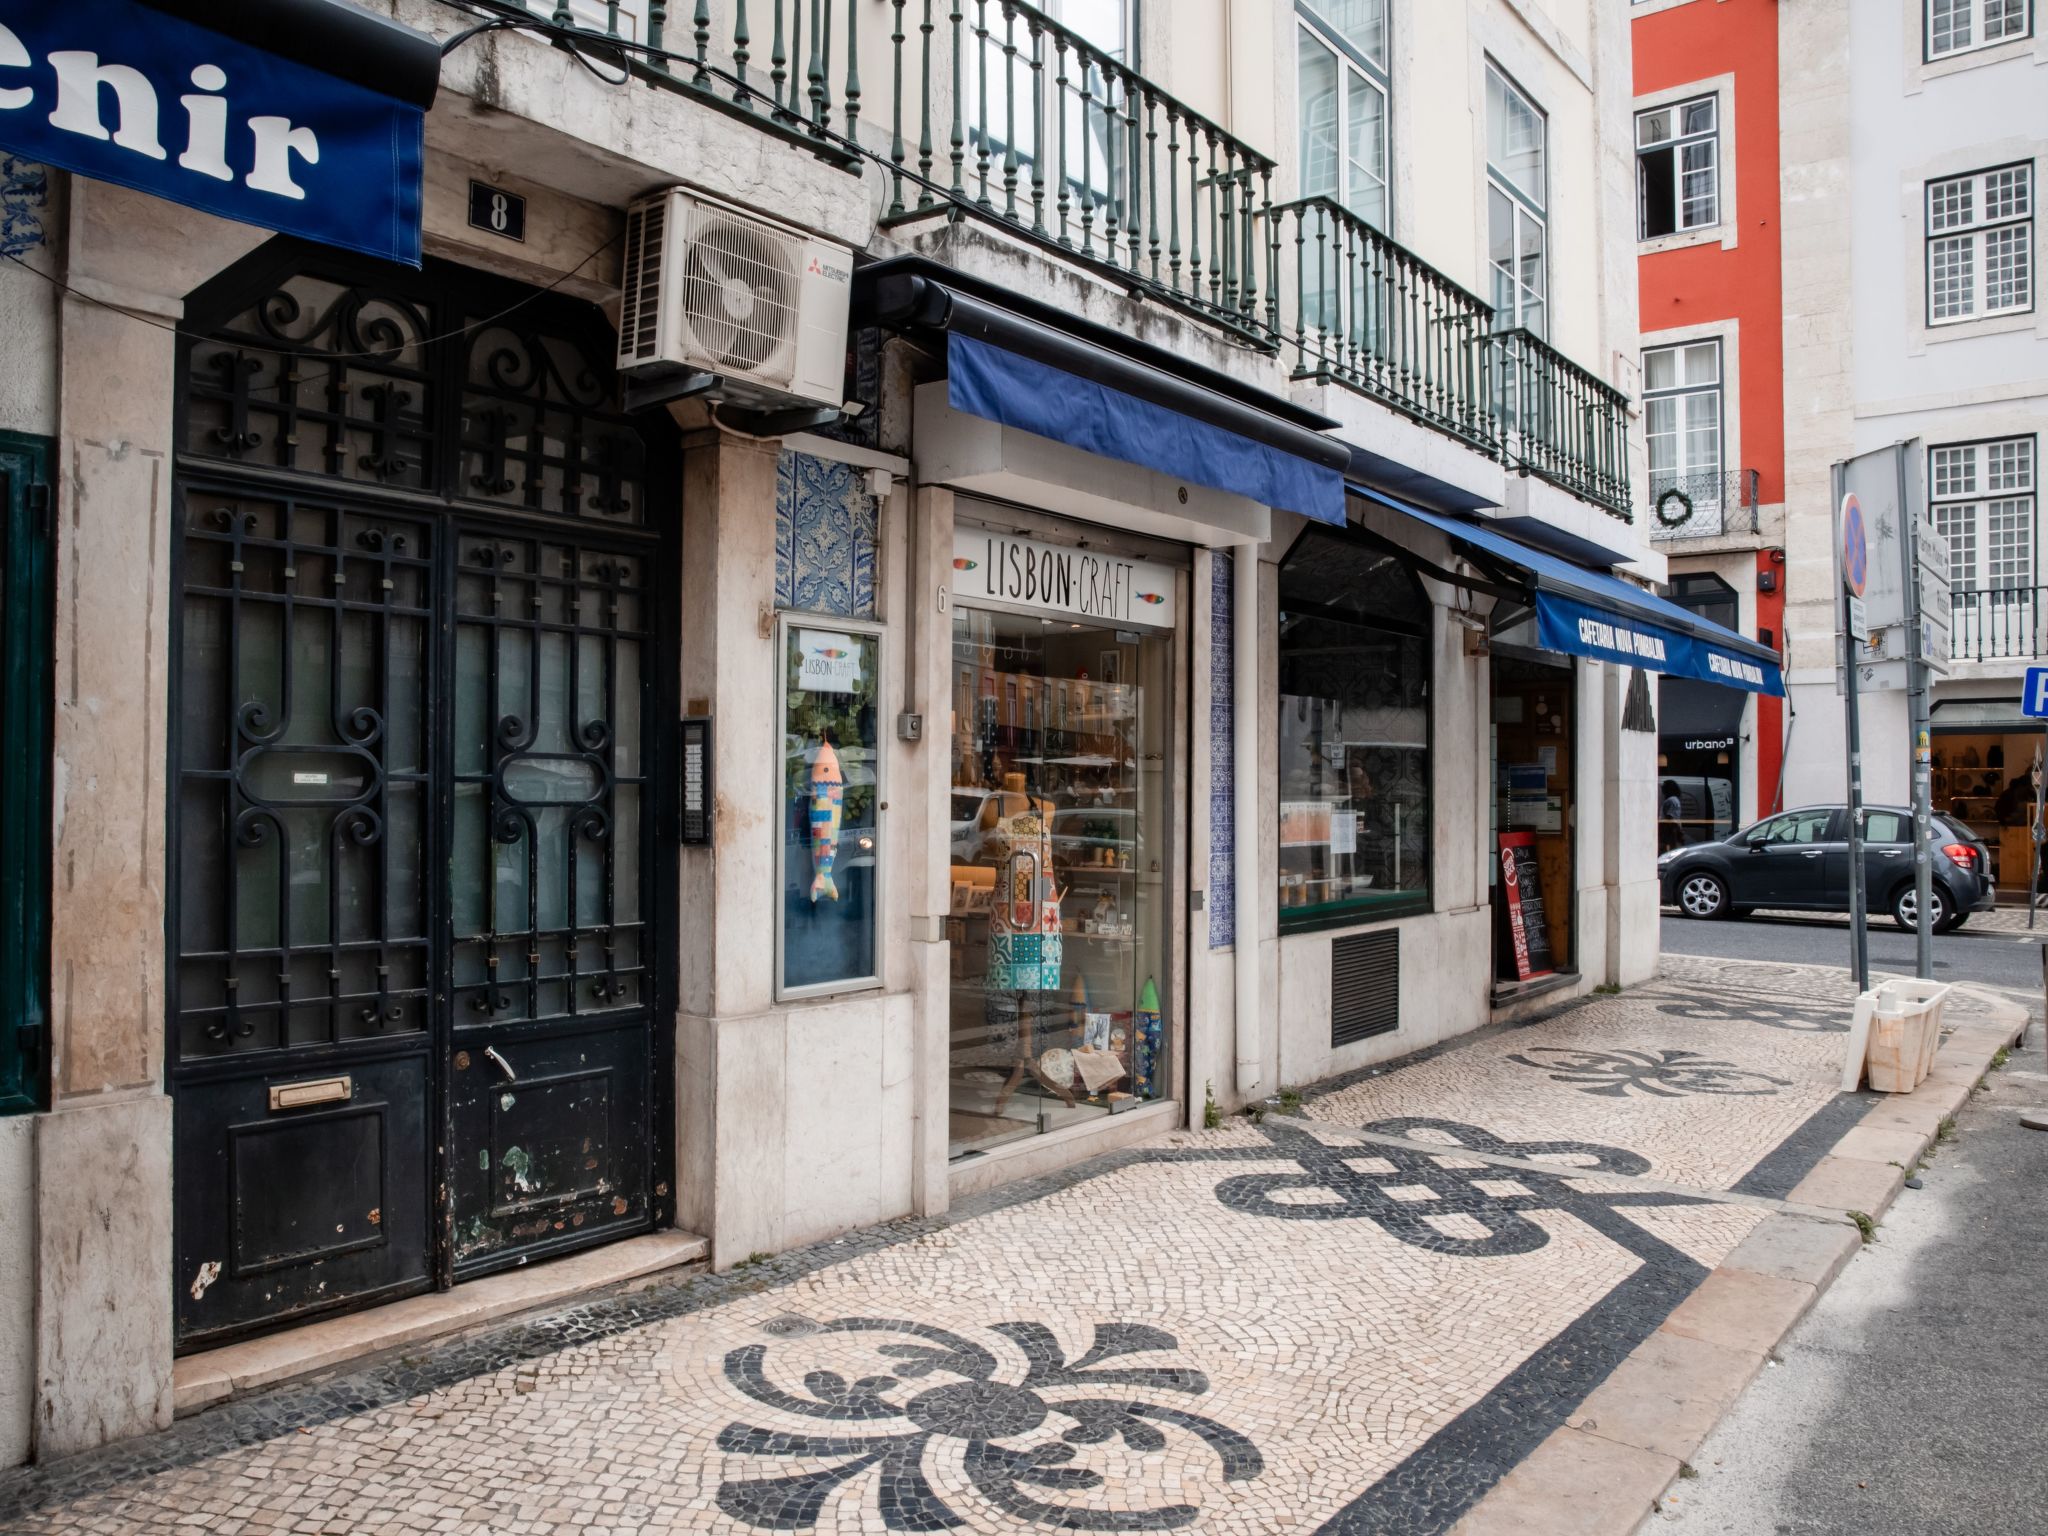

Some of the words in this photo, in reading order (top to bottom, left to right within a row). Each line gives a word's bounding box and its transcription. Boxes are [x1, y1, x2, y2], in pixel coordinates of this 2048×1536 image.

[490, 193, 509, 231] 8
[936, 585, 947, 613] 6
[1578, 617, 1616, 650] CAFETARIA
[1615, 627, 1634, 654] NOVA
[805, 658, 832, 676] LISBON
[1685, 740, 1726, 750] urbano
